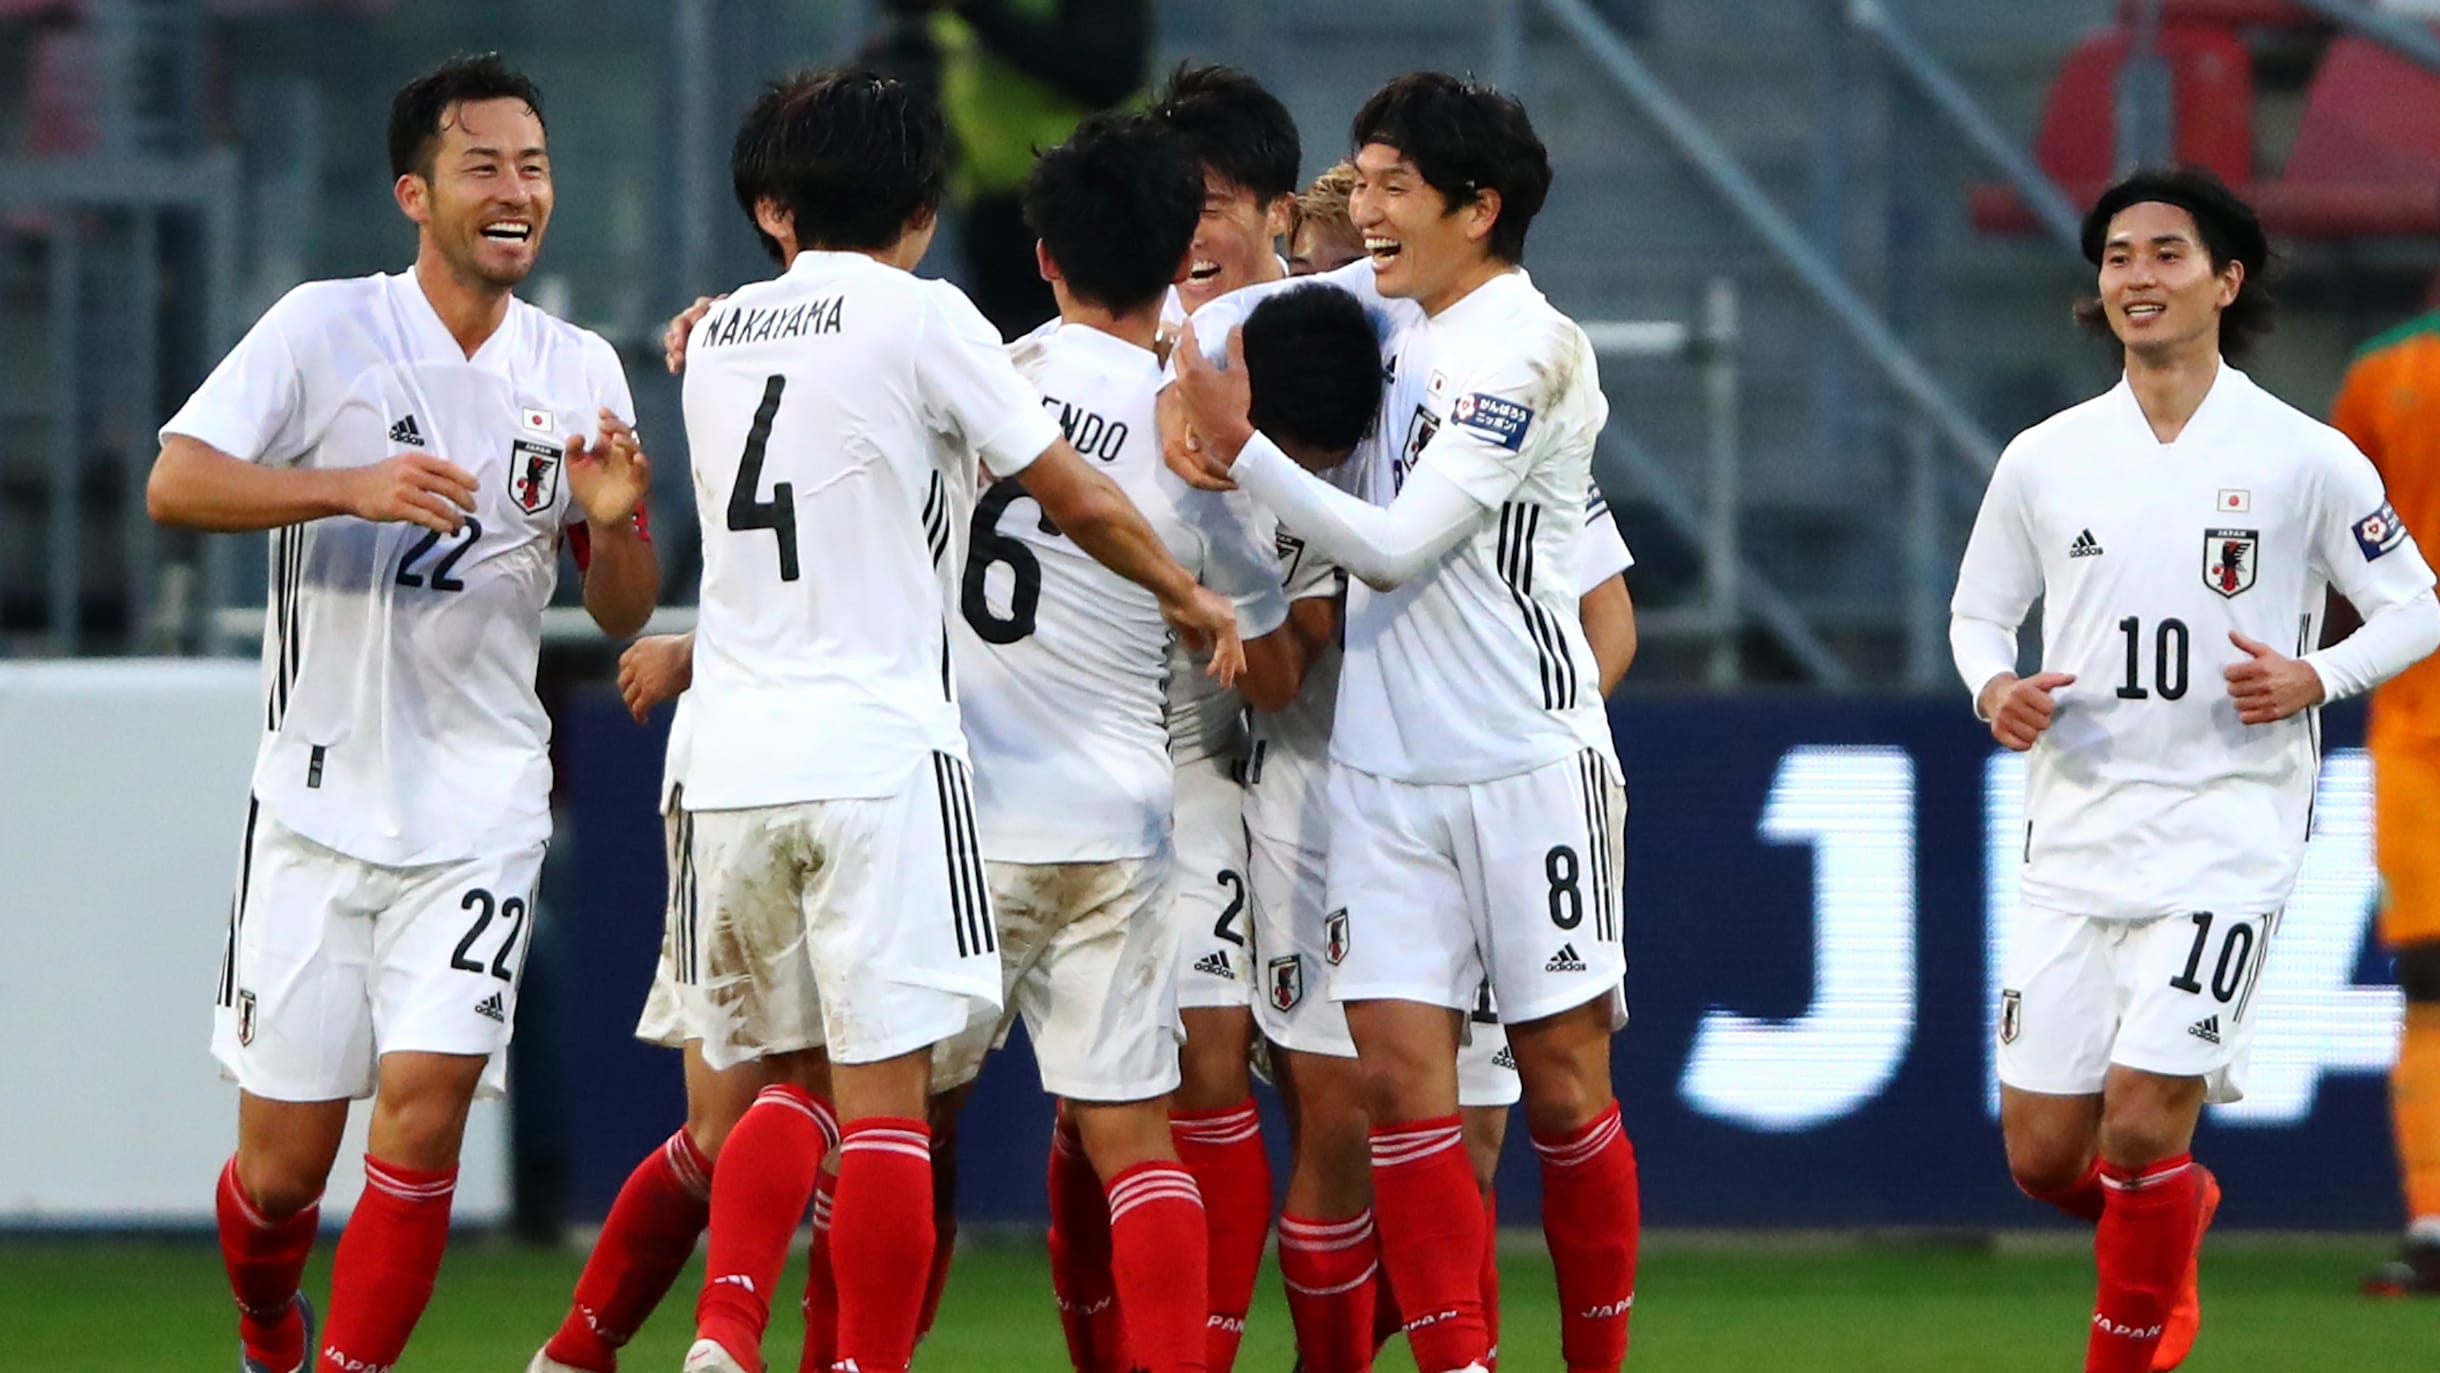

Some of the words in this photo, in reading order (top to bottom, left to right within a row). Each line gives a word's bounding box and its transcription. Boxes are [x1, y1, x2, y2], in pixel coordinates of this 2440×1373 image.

[702, 295, 844, 348] NAKAYAMA
[1041, 394, 1128, 462] NDO
[727, 374, 800, 582] 4
[396, 515, 482, 591] 22
[962, 477, 1063, 645] 6
[2116, 616, 2189, 700] 10
[1214, 869, 1245, 947] 2
[1545, 844, 1583, 930] 8
[450, 887, 525, 982] 22
[1194, 961, 1235, 980] adidas
[1545, 959, 1587, 972] adidas
[2169, 910, 2253, 1003] 10
[1206, 1314, 1245, 1333] PAN
[2093, 1312, 2162, 1338] JAPAN
